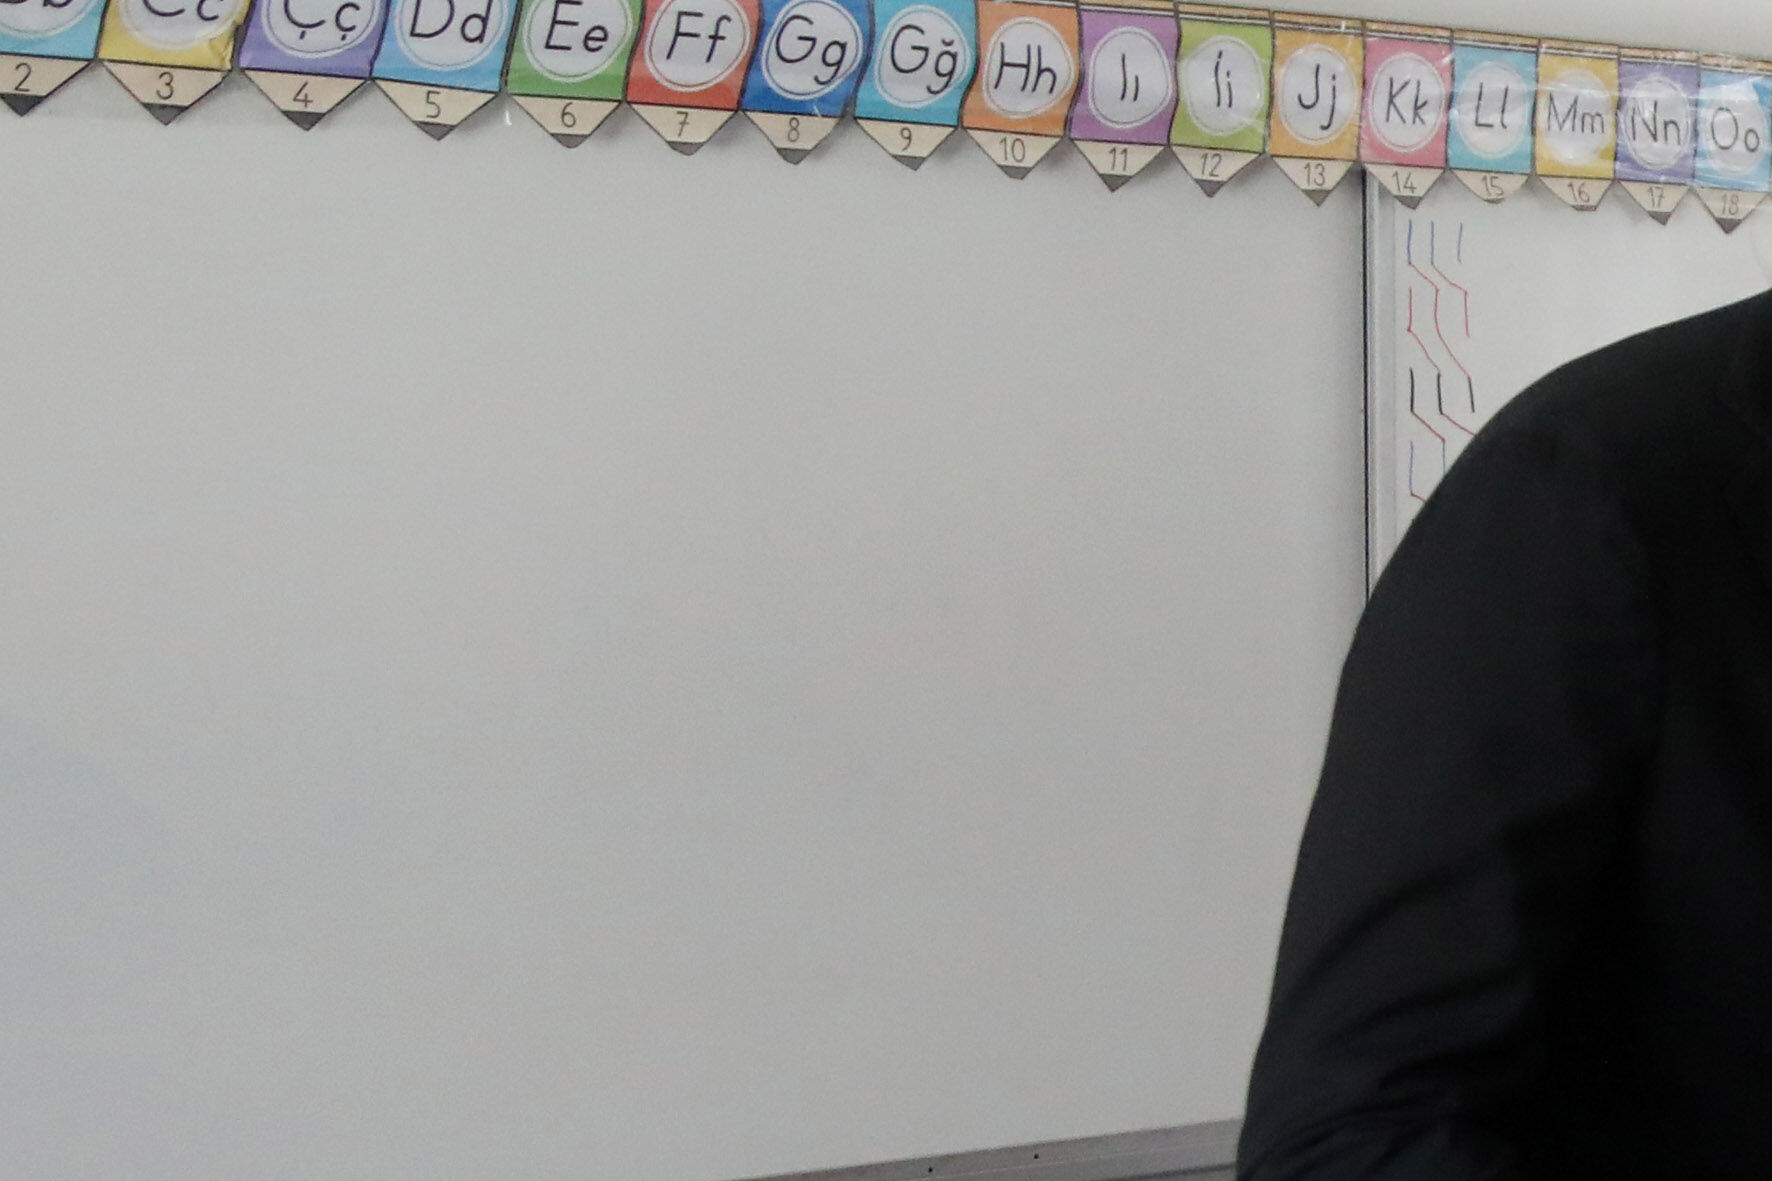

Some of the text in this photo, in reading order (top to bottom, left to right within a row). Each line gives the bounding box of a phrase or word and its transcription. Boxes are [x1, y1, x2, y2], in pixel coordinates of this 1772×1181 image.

[284, 0, 361, 41] Çç
[409, 0, 488, 43] Dd
[544, 0, 610, 52] Ee
[666, 11, 732, 63] Ff
[775, 14, 848, 86] Gg
[14, 62, 32, 92] 2
[993, 41, 1058, 95] Hh
[1214, 50, 1233, 108] İi
[156, 71, 174, 100] 3
[292, 81, 314, 109] 4
[1298, 63, 1336, 131] Jj
[425, 90, 441, 119] 5
[560, 102, 576, 128] 6
[1384, 76, 1428, 125] Kk
[1474, 81, 1509, 129] Ll
[1547, 91, 1605, 134] Mm
[676, 112, 690, 137] 7
[787, 116, 800, 142] 8
[1631, 99, 1681, 145] Nn
[1711, 107, 1760, 152] Oo
[900, 127, 913, 151] 9
[1000, 137, 1026, 163] 10
[1109, 146, 1128, 171] 11
[1199, 154, 1221, 178] 12
[1304, 162, 1326, 188] 13
[1392, 170, 1417, 194] 14
[1482, 175, 1504, 197] 15
[1568, 181, 1590, 204] 16
[1649, 186, 1665, 208] 17
[1722, 193, 1740, 215] 18
